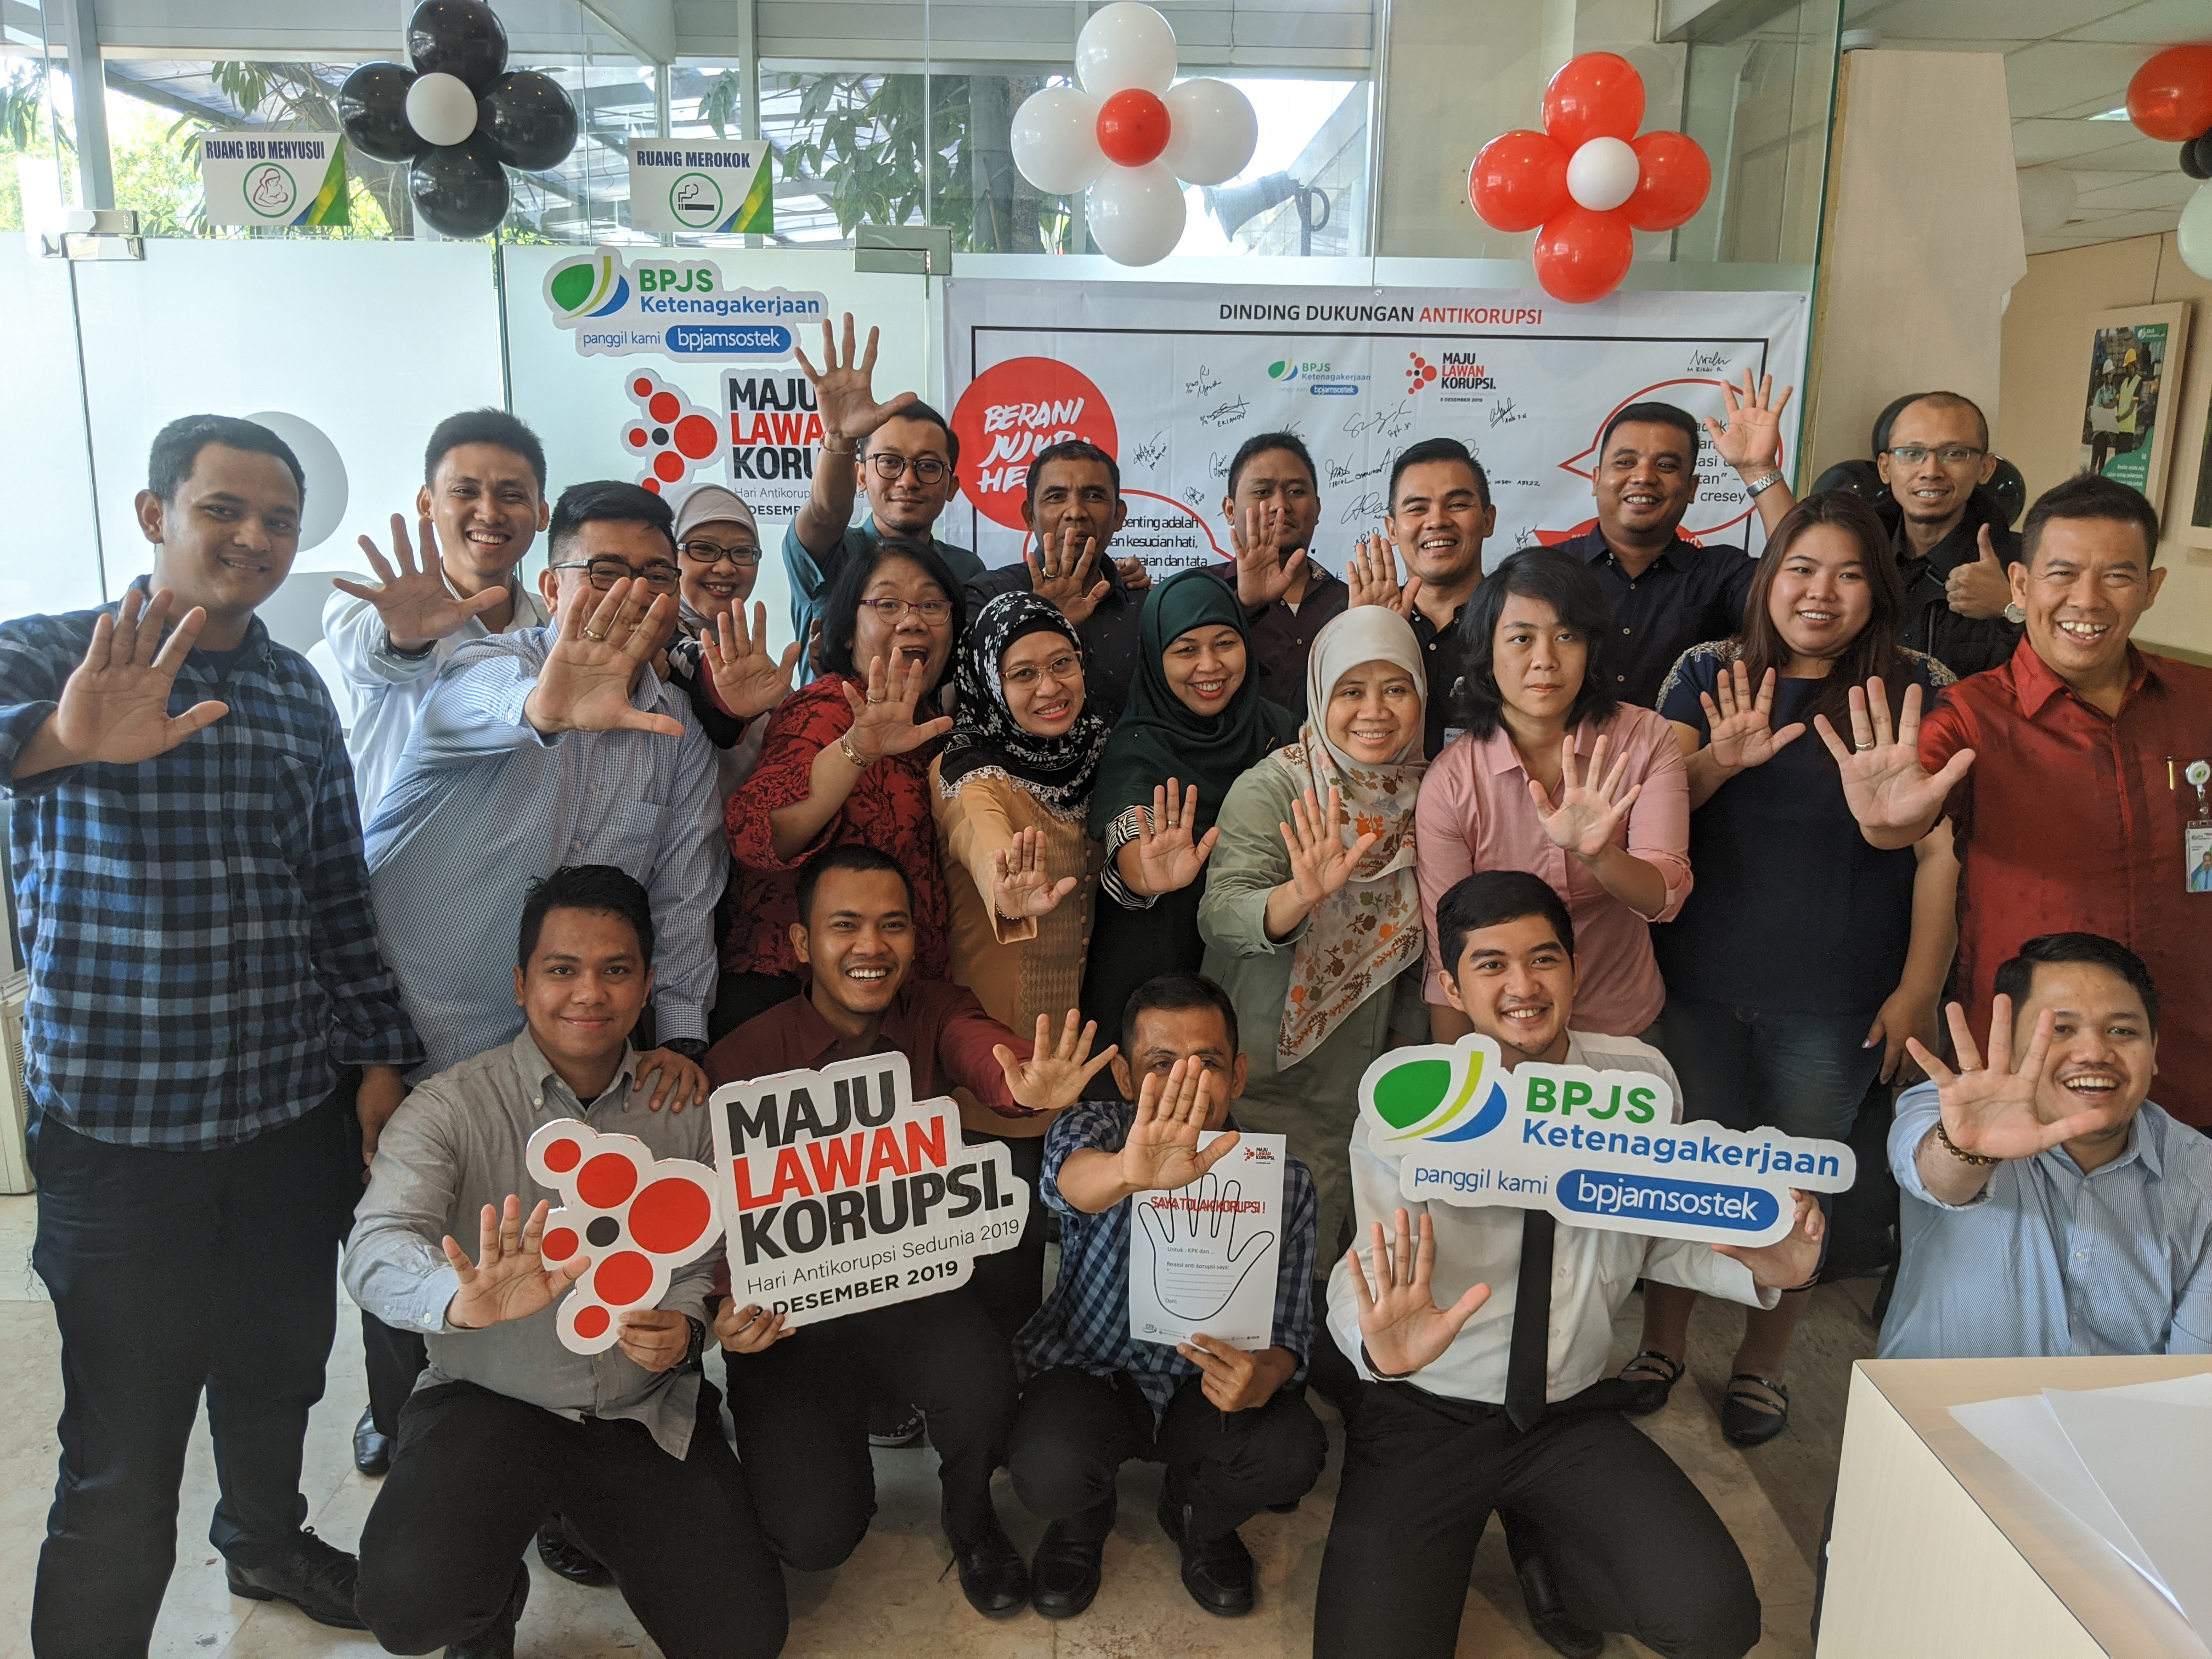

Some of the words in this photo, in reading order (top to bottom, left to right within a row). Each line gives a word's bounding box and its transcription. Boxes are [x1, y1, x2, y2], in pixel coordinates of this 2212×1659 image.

[205, 140, 244, 160] RUANG
[246, 141, 265, 160] IBU
[268, 141, 325, 160] MENYUSUI
[637, 150, 682, 167] RUANG
[685, 151, 751, 168] MEROKOK
[639, 268, 713, 292] BPJS
[641, 295, 820, 317] Ketenagakerjaan
[1220, 304, 1300, 321] DINDING
[1306, 305, 1414, 323] DUKUNGAN
[1419, 307, 1543, 325] ANTIKORUPSI
[583, 331, 628, 348] panggil
[632, 330, 661, 345] kami
[678, 328, 780, 352] bpjamsostek
[1302, 363, 1331, 372] BPJS
[1442, 352, 1476, 365] MAJU
[1301, 373, 1371, 382] Ketenagakerjaan
[1442, 365, 1485, 377] LAWAN
[1313, 385, 1355, 395] bpjamsostek
[1441, 377, 1497, 390] KORUPSI.
[729, 378, 817, 411] MAJU
[984, 397, 1085, 435] BERANI
[731, 413, 823, 446] LAWA
[732, 447, 820, 480] KORU
[735, 488, 756, 498] Hari
[760, 488, 810, 500] Antikorup
[1700, 492, 1746, 504] cresey
[748, 505, 801, 516] DESEM
[1162, 516, 1199, 528] adalah
[1127, 535, 1174, 548] kesucian
[1175, 535, 1198, 549] hati,
[1164, 554, 1184, 567] dan
[1186, 555, 1207, 567] tata
[1525, 1076, 1657, 1124] BPJS
[726, 1070, 896, 1156] MAJU
[1522, 1118, 1840, 1178] Ketenagakerjaan
[732, 1115, 947, 1211] LAWAN
[1150, 1196, 1180, 1210] SAYA
[1180, 1198, 1216, 1212] TOLAK
[1414, 1165, 1491, 1193] panggil
[1498, 1171, 1548, 1195] kami
[1578, 1173, 1758, 1222] bpjamsostek
[738, 1159, 1014, 1266] KORUPSI.
[747, 1271, 787, 1295] Hari
[793, 1246, 896, 1285] Antikorupsi
[902, 1231, 975, 1259] Sedunia
[980, 1219, 1020, 1241] 2019
[772, 1274, 900, 1317] DESEMBER
[907, 1260, 958, 1285] 2019
